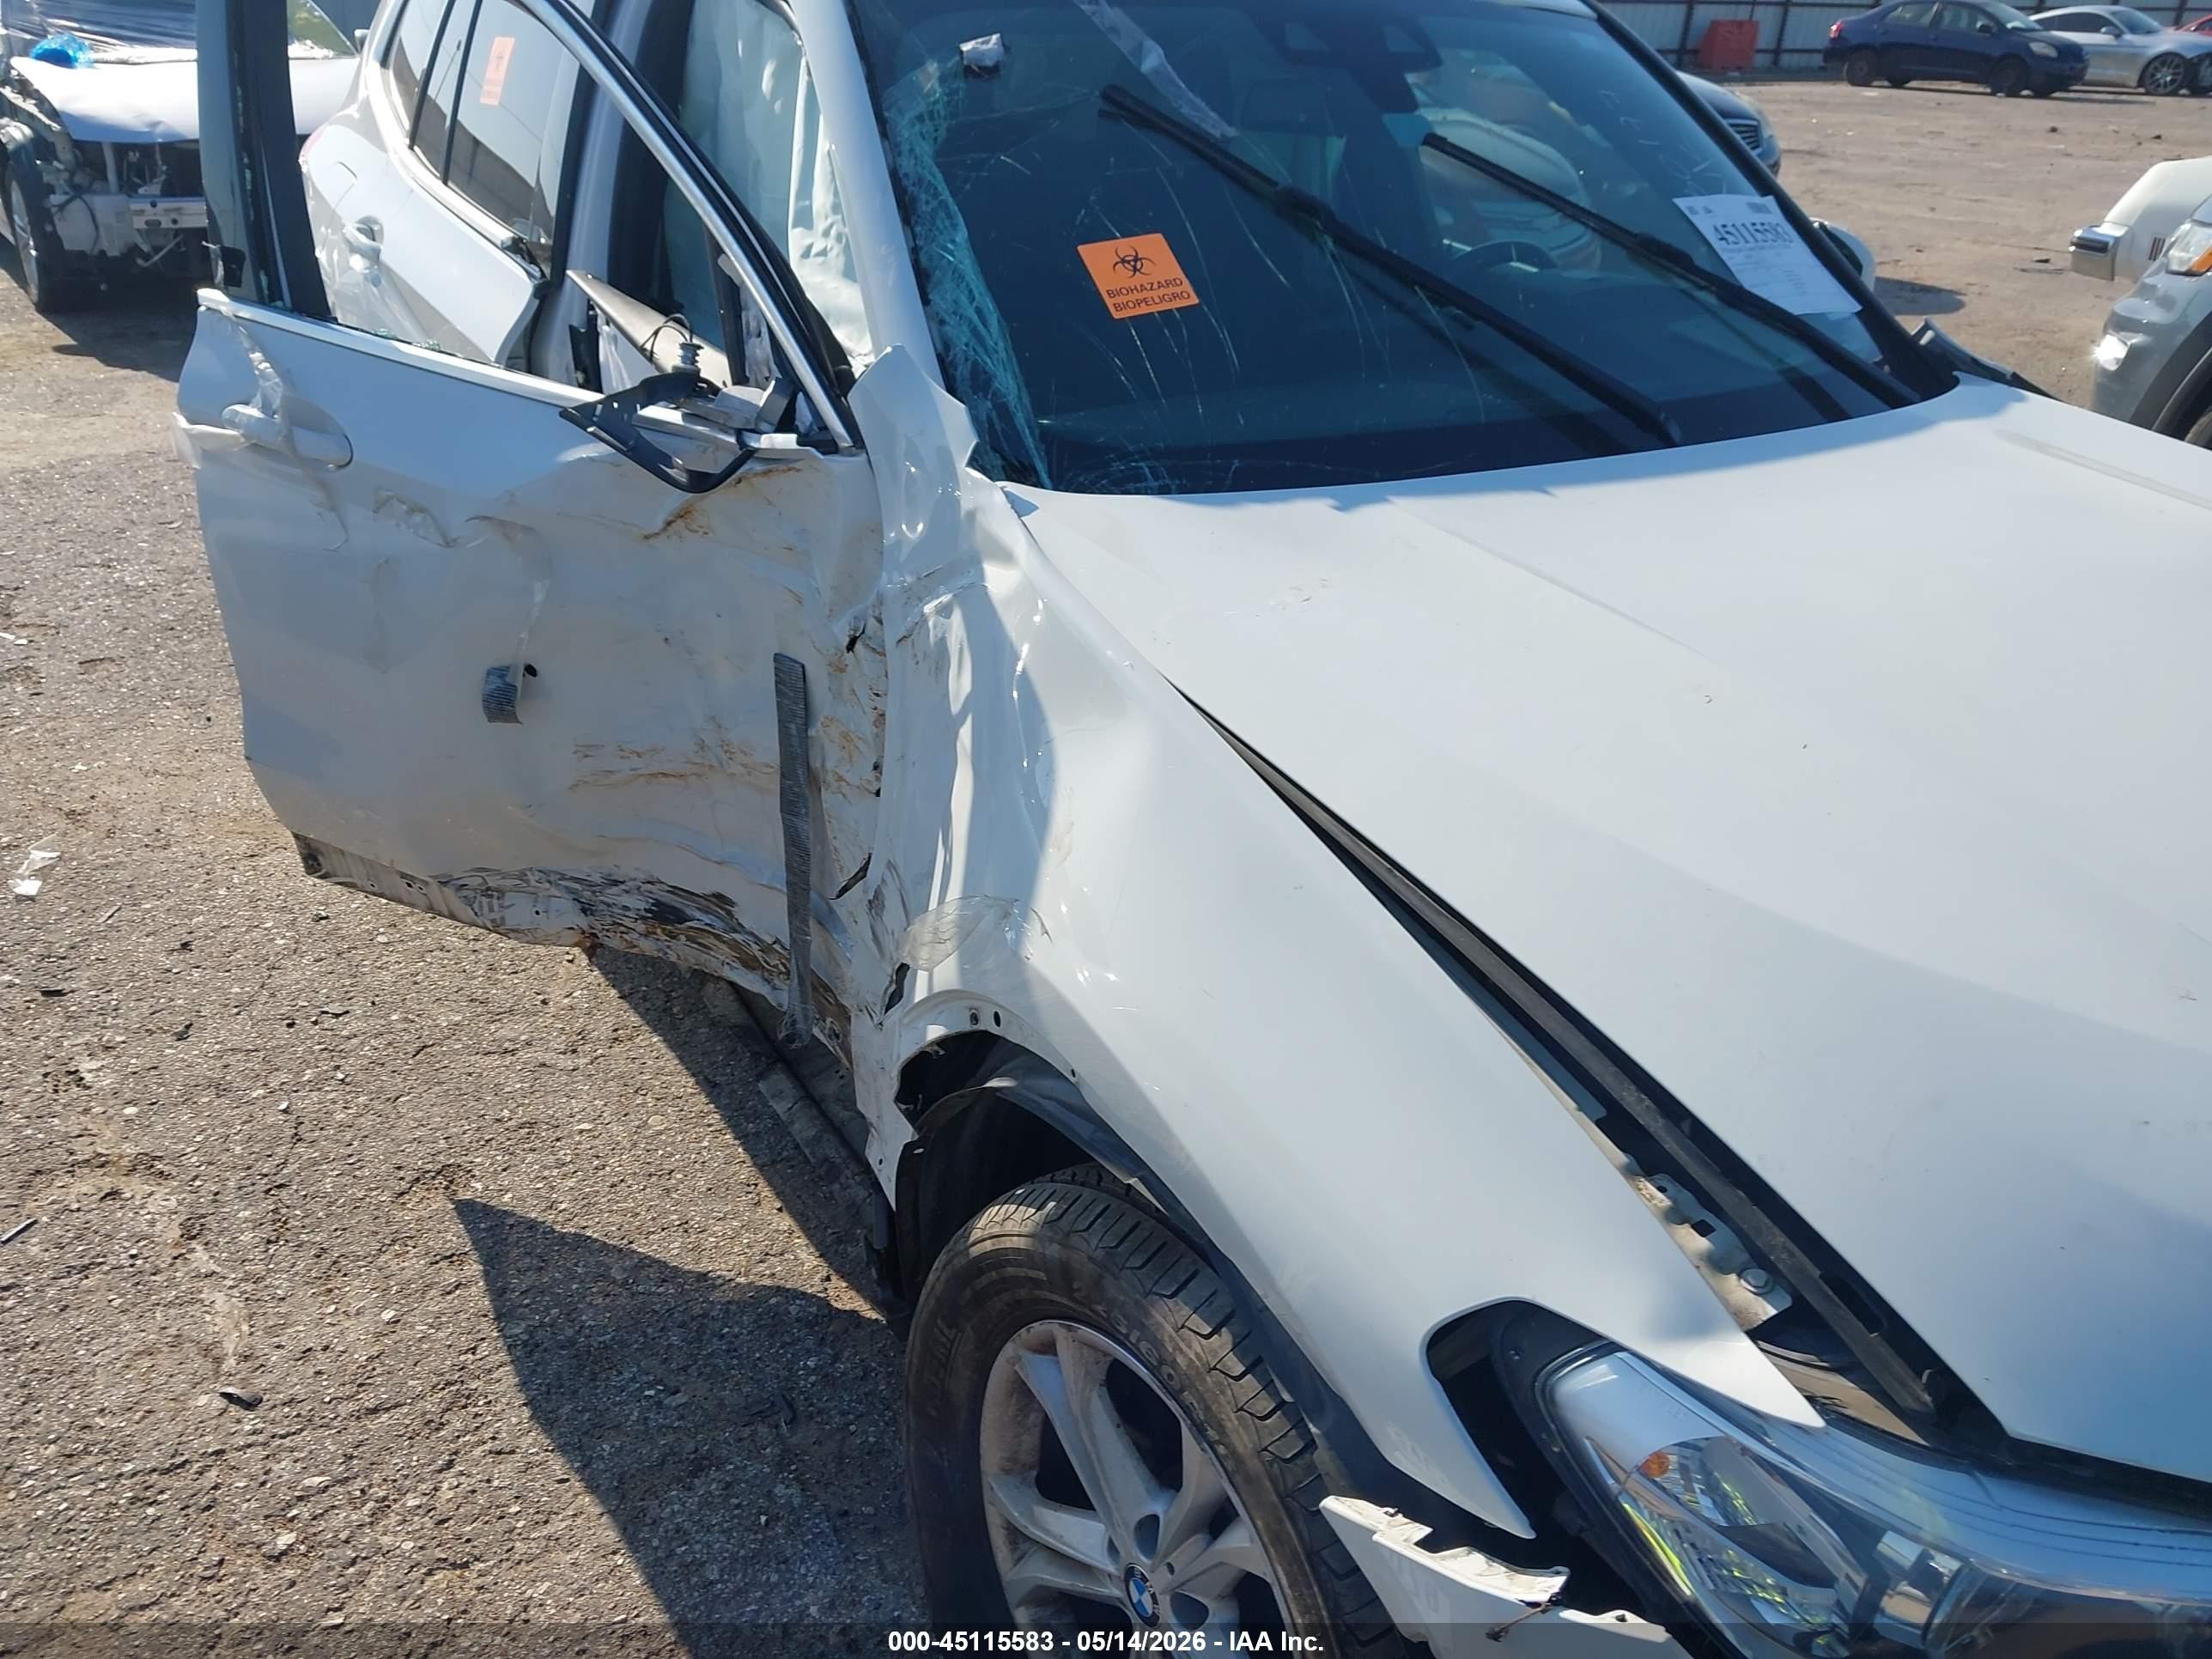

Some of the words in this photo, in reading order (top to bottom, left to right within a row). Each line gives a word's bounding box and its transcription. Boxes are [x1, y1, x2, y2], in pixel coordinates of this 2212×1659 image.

[1711, 221, 1795, 246] 45115583
[1105, 277, 1183, 299] BIOHAZARD
[1113, 291, 1191, 313] BIOPELIGRO
